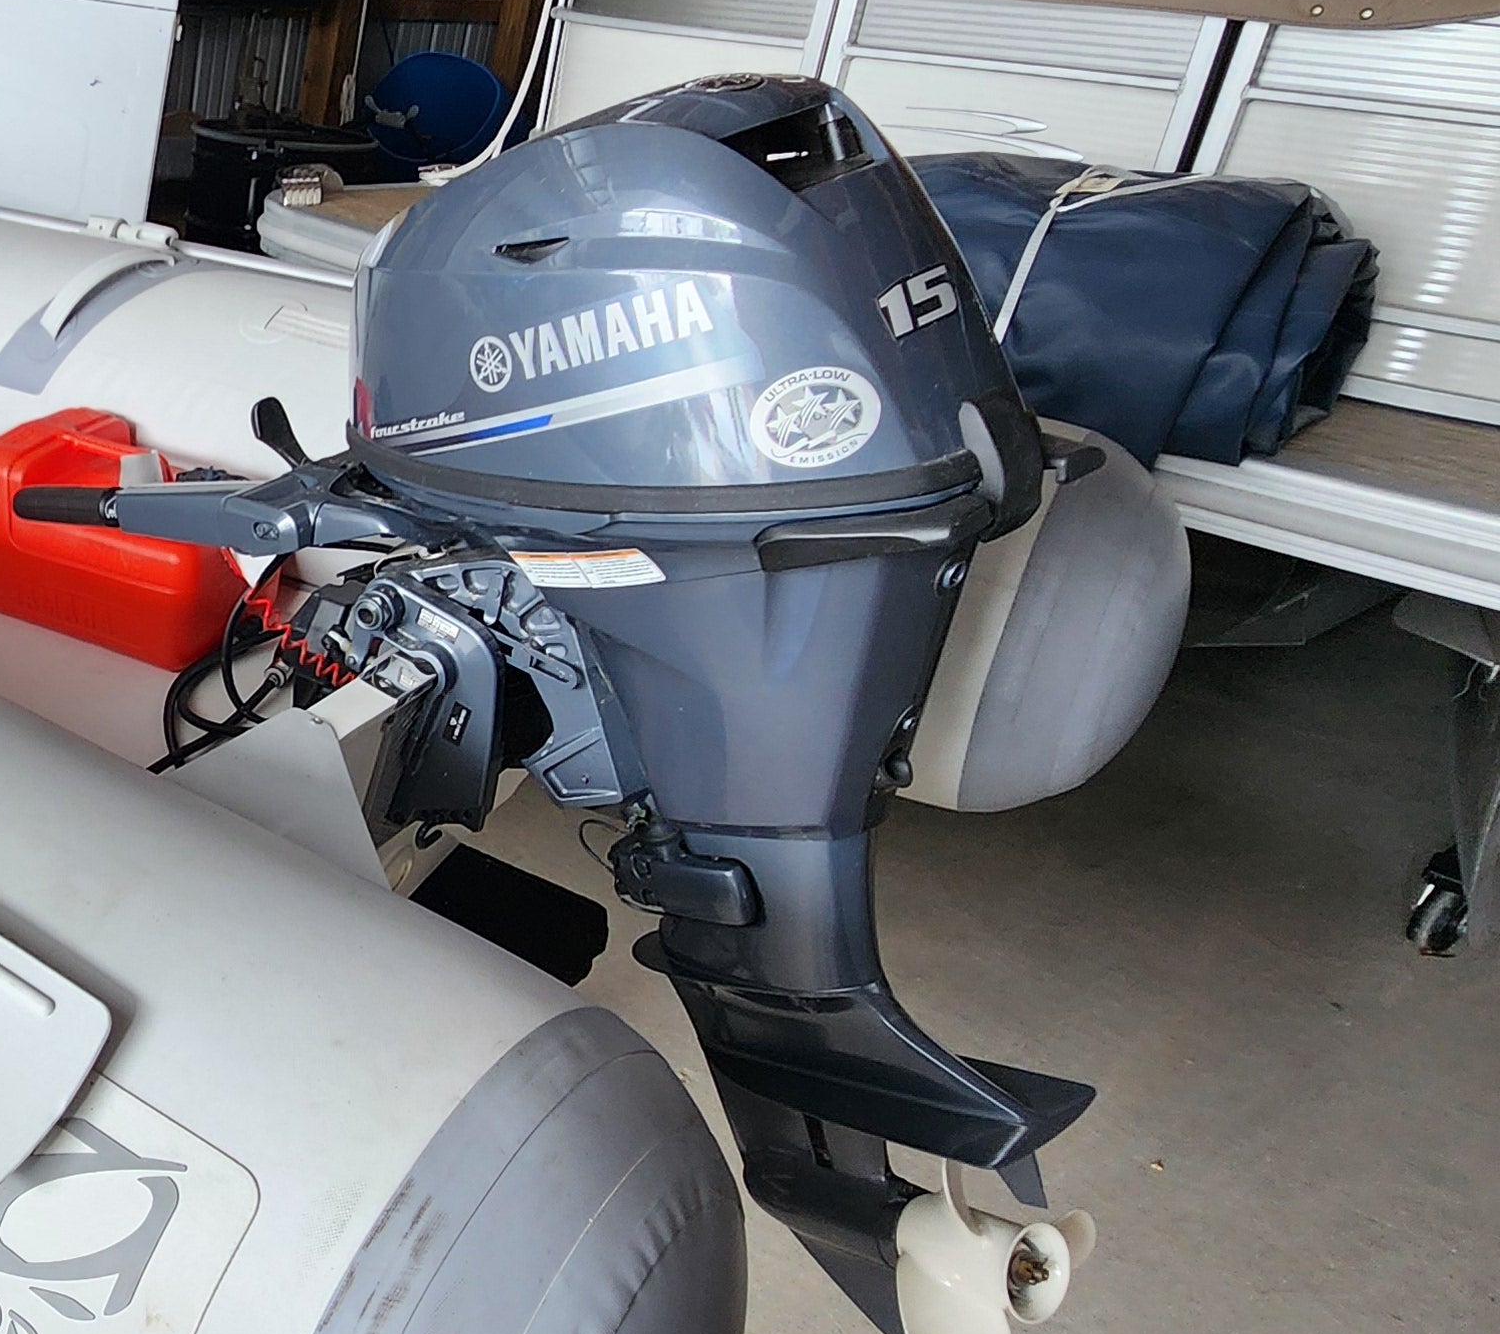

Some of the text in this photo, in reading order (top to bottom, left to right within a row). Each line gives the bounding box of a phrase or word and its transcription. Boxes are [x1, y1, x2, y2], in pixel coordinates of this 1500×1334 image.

[878, 264, 958, 339] 15
[508, 280, 714, 381] YAMAHA
[370, 411, 466, 440] fourstroke
[789, 439, 859, 465] EMISSION
